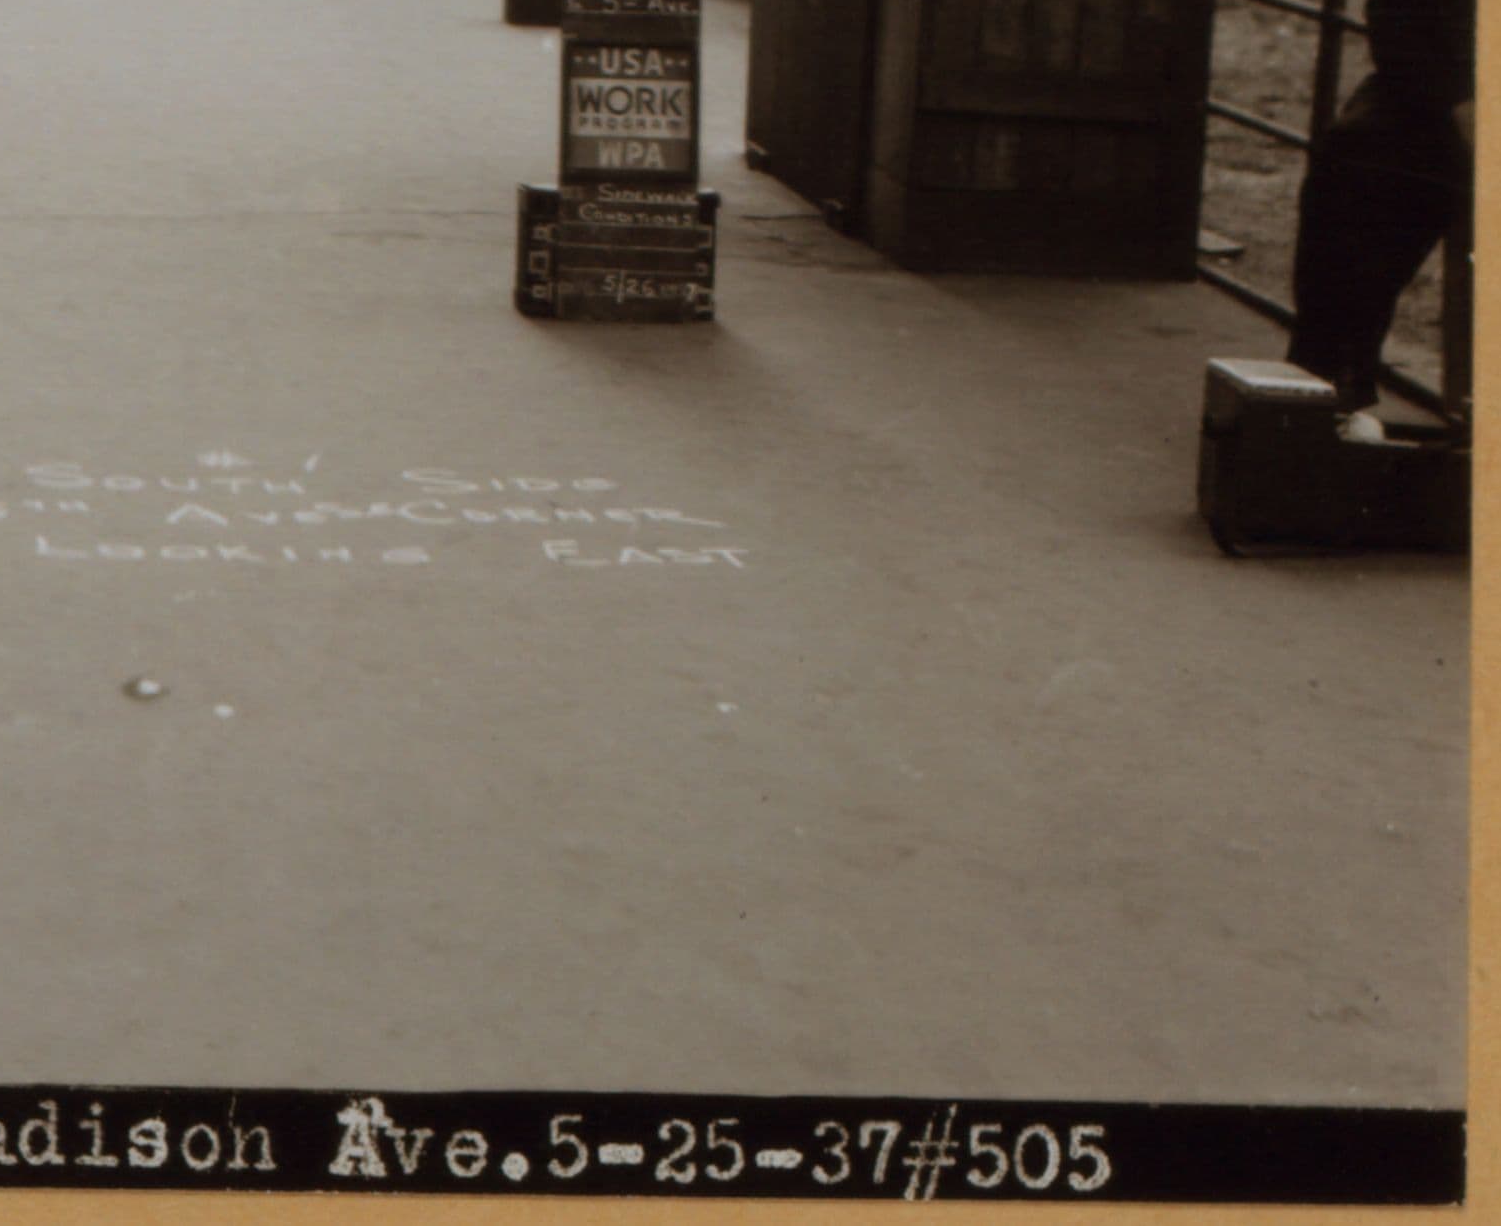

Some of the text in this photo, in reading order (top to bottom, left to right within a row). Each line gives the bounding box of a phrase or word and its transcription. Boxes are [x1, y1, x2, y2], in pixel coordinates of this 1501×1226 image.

[599, 47, 665, 76] USA
[577, 85, 684, 116] WORK
[579, 117, 683, 131] PROGRAM
[598, 141, 665, 168] WPA
[25, 461, 621, 494] SOUTH SIDE
[543, 539, 751, 569] EAST
